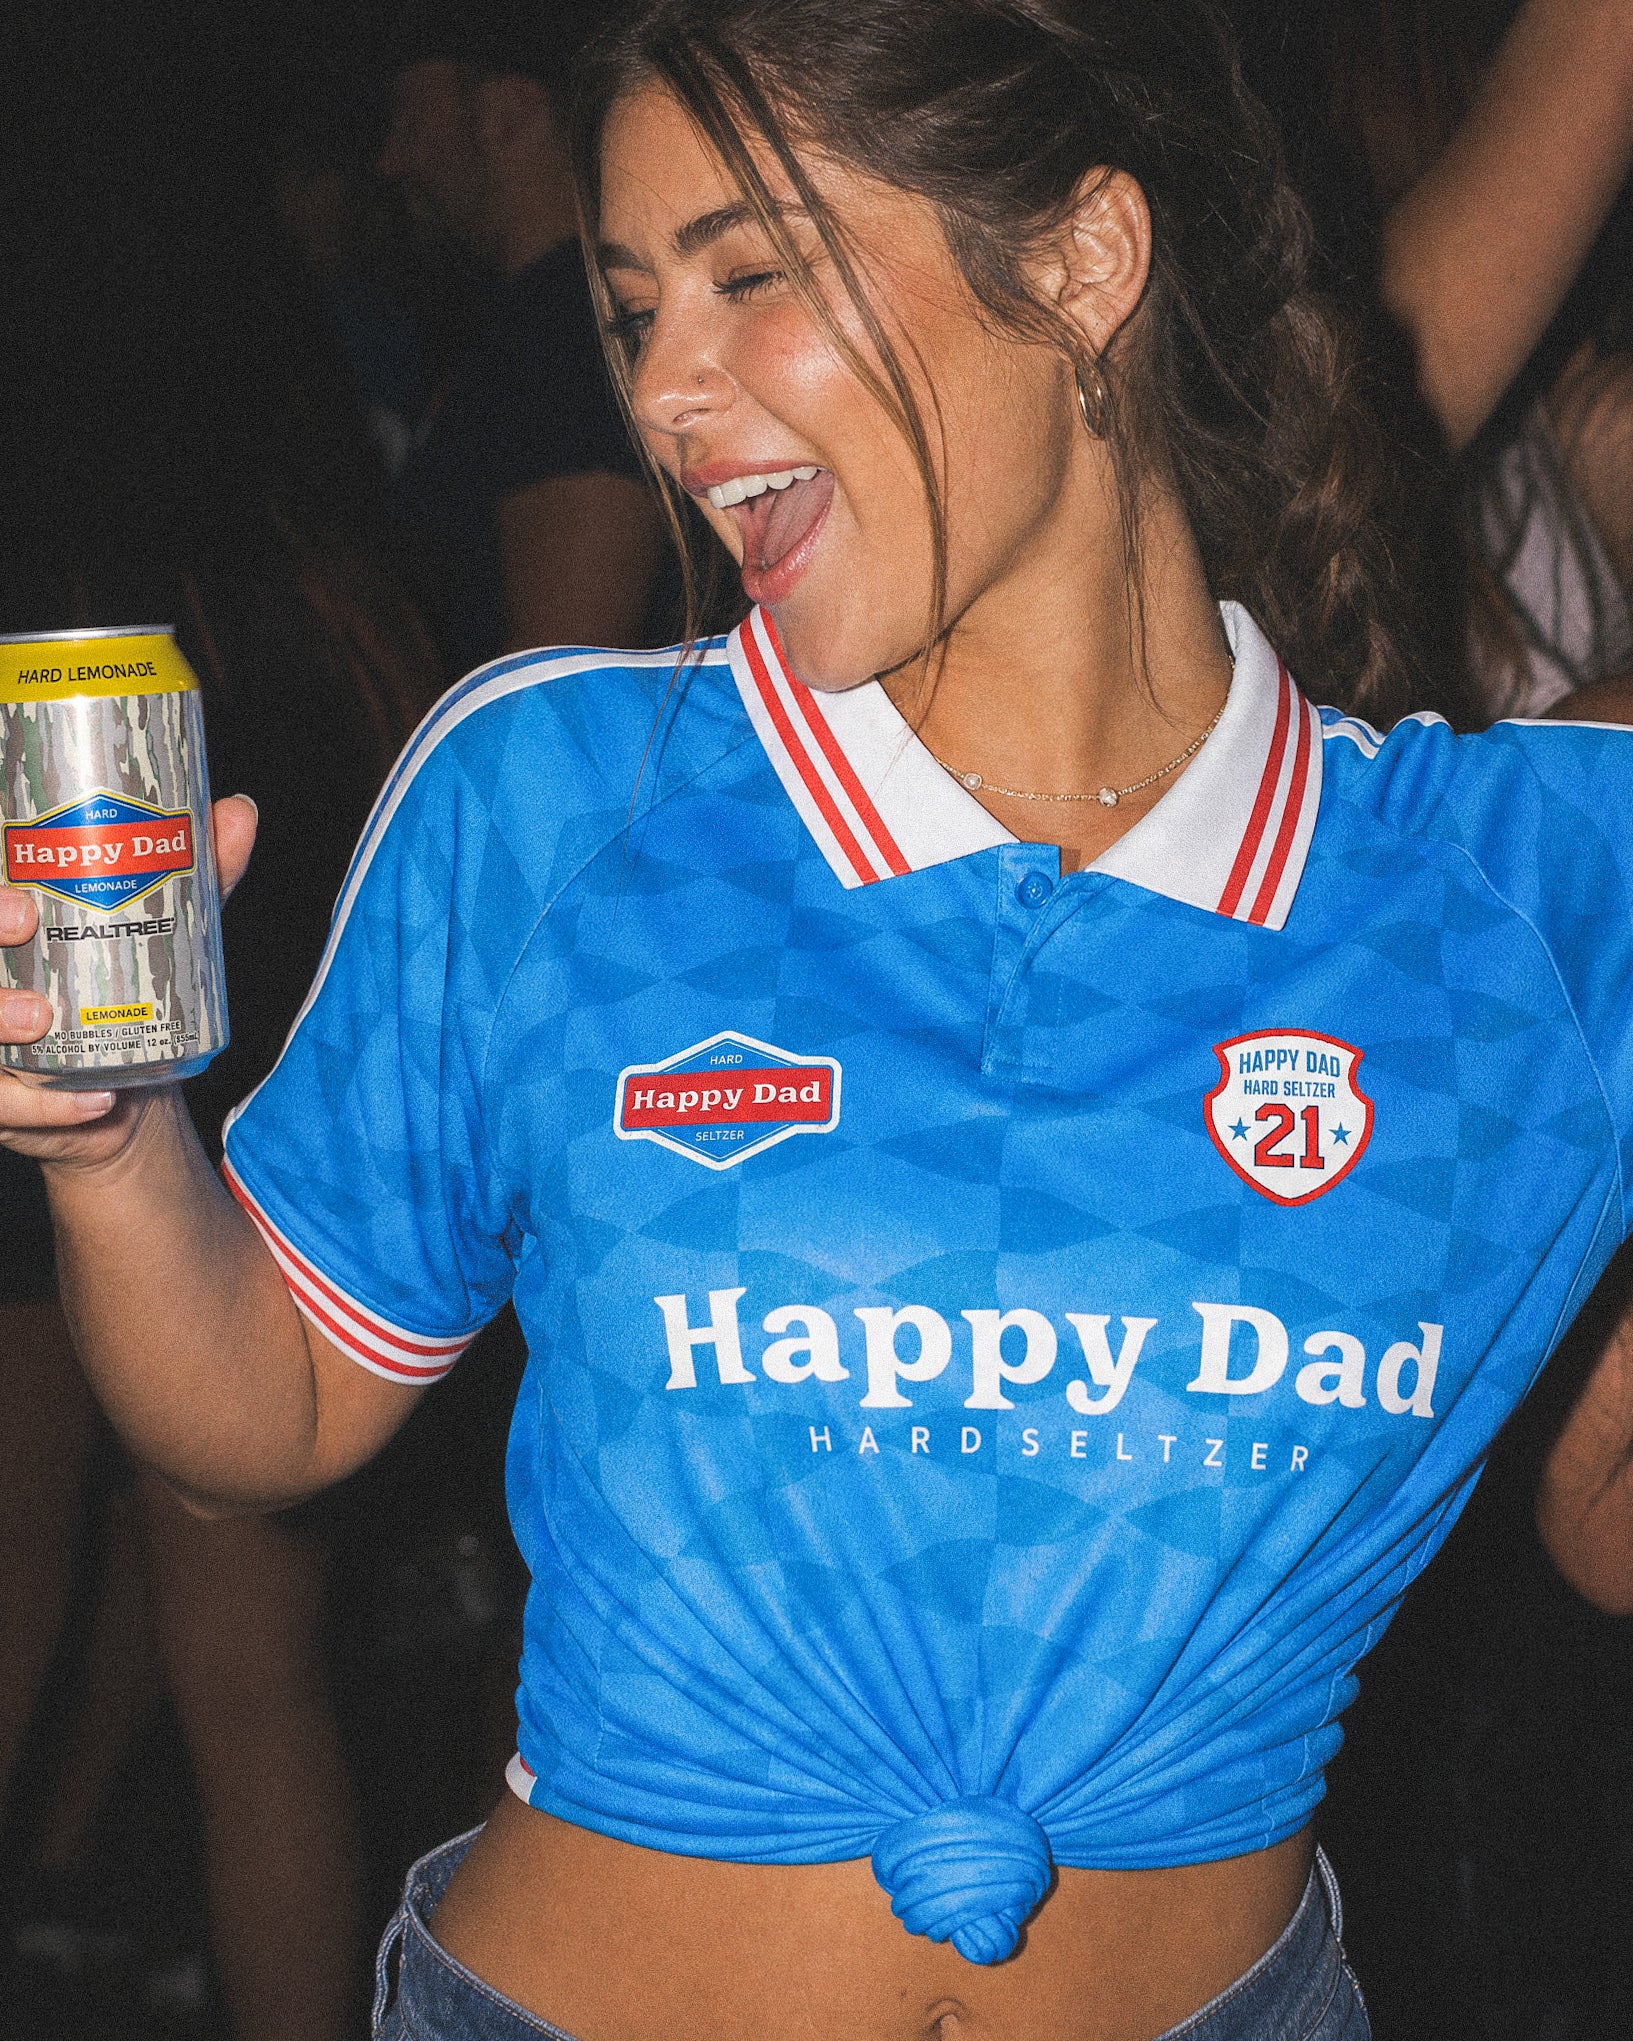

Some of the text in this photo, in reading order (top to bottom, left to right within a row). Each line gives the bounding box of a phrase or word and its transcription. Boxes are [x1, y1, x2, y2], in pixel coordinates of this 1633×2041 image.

[17, 661, 157, 685] HARD LEMONADE
[85, 808, 118, 820] HARD
[14, 829, 187, 868] Happy Dad
[75, 879, 138, 894] LEMONADE
[46, 918, 174, 942] REALTREE
[86, 1006, 149, 1021] LEMONADE
[70, 1029, 112, 1040] BUBBLES
[121, 1024, 157, 1036] GLUTEN
[160, 1021, 181, 1032] FREE
[45, 1044, 86, 1054] ALCOHOL
[88, 1043, 100, 1053] BY
[104, 1041, 141, 1052] VOLUME
[147, 1038, 157, 1047] 12
[710, 1054, 743, 1065] HARD
[1239, 1048, 1341, 1078] HAPPY DAD
[631, 1081, 821, 1112] Happy Dad
[1243, 1079, 1336, 1098] HARD SELTZER
[695, 1130, 745, 1141] SELTZER
[1254, 1103, 1325, 1170] 21
[653, 1286, 1444, 1418] Happy Dad
[808, 1425, 1310, 1473] HARD SELTZER
